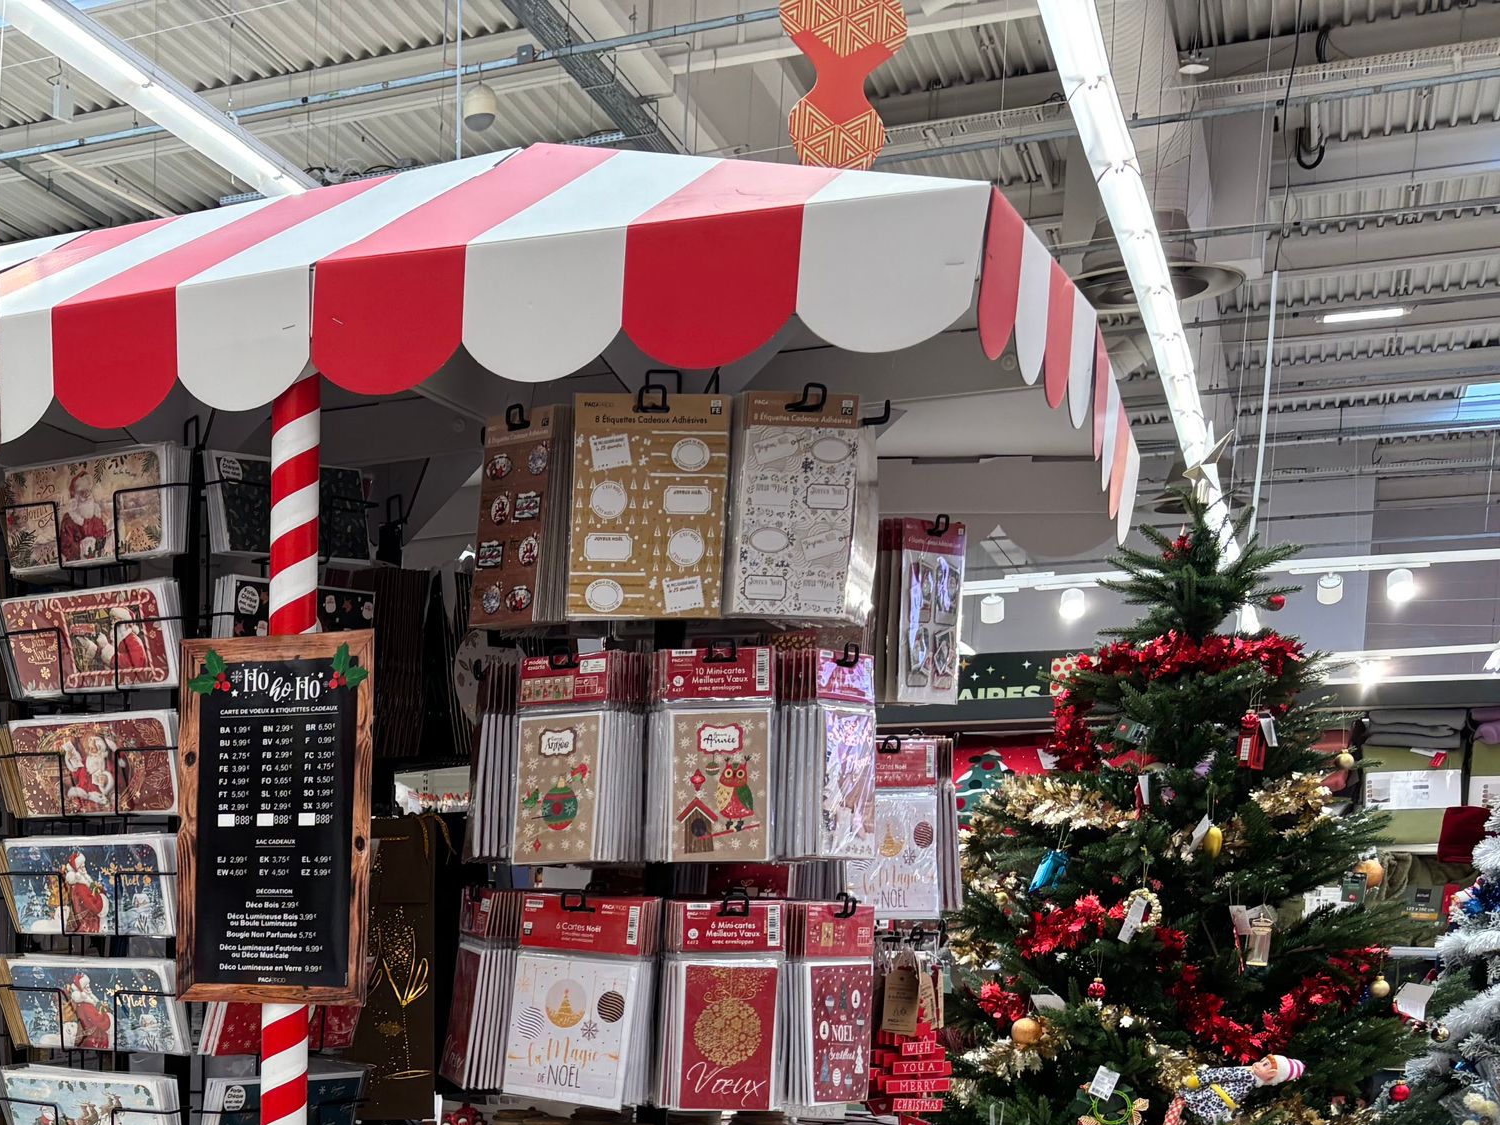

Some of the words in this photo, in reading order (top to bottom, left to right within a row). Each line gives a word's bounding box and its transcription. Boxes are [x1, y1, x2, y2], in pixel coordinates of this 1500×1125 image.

[602, 414, 636, 426] Étiquettes
[637, 415, 670, 424] Cadeaux
[671, 414, 708, 425] Adhésives
[760, 412, 790, 425] Étiquettes
[791, 414, 822, 424] Cadeaux
[823, 415, 852, 425] Adhésives
[706, 666, 746, 675] Mini-cartes
[692, 675, 724, 684] Meilleurs
[711, 684, 742, 692] enveloppes
[220, 708, 239, 716] CARTE
[249, 707, 270, 715] VOEUX
[310, 704, 338, 712] CADEAUX
[255, 887, 293, 895] DÉCORATION
[245, 901, 263, 909] Déco
[264, 901, 280, 909] Bois
[227, 912, 245, 920] Déco
[240, 919, 260, 927] Boule
[561, 922, 585, 931] Cartes
[586, 925, 602, 933] Noël
[717, 920, 756, 930] Mini-cartes
[226, 930, 250, 939] Bougie
[266, 931, 297, 939] Parfumée
[705, 929, 738, 938] Meilleurs
[739, 929, 761, 937] Vœux
[724, 938, 754, 946] enveloppes
[219, 943, 237, 951] Déco
[238, 944, 274, 952] Lumineuse
[275, 944, 302, 952] Feutrine
[260, 951, 289, 959] Musicale
[238, 963, 274, 971] Lumineuse
[548, 1035, 599, 1068] Magie
[907, 1043, 931, 1053] WISH
[902, 1062, 925, 1072] YOU
[547, 1063, 581, 1089] NOËL
[686, 1060, 767, 1107] Vœux
[900, 1080, 936, 1092] MERRY
[897, 1099, 939, 1110] CHRISTMAS
